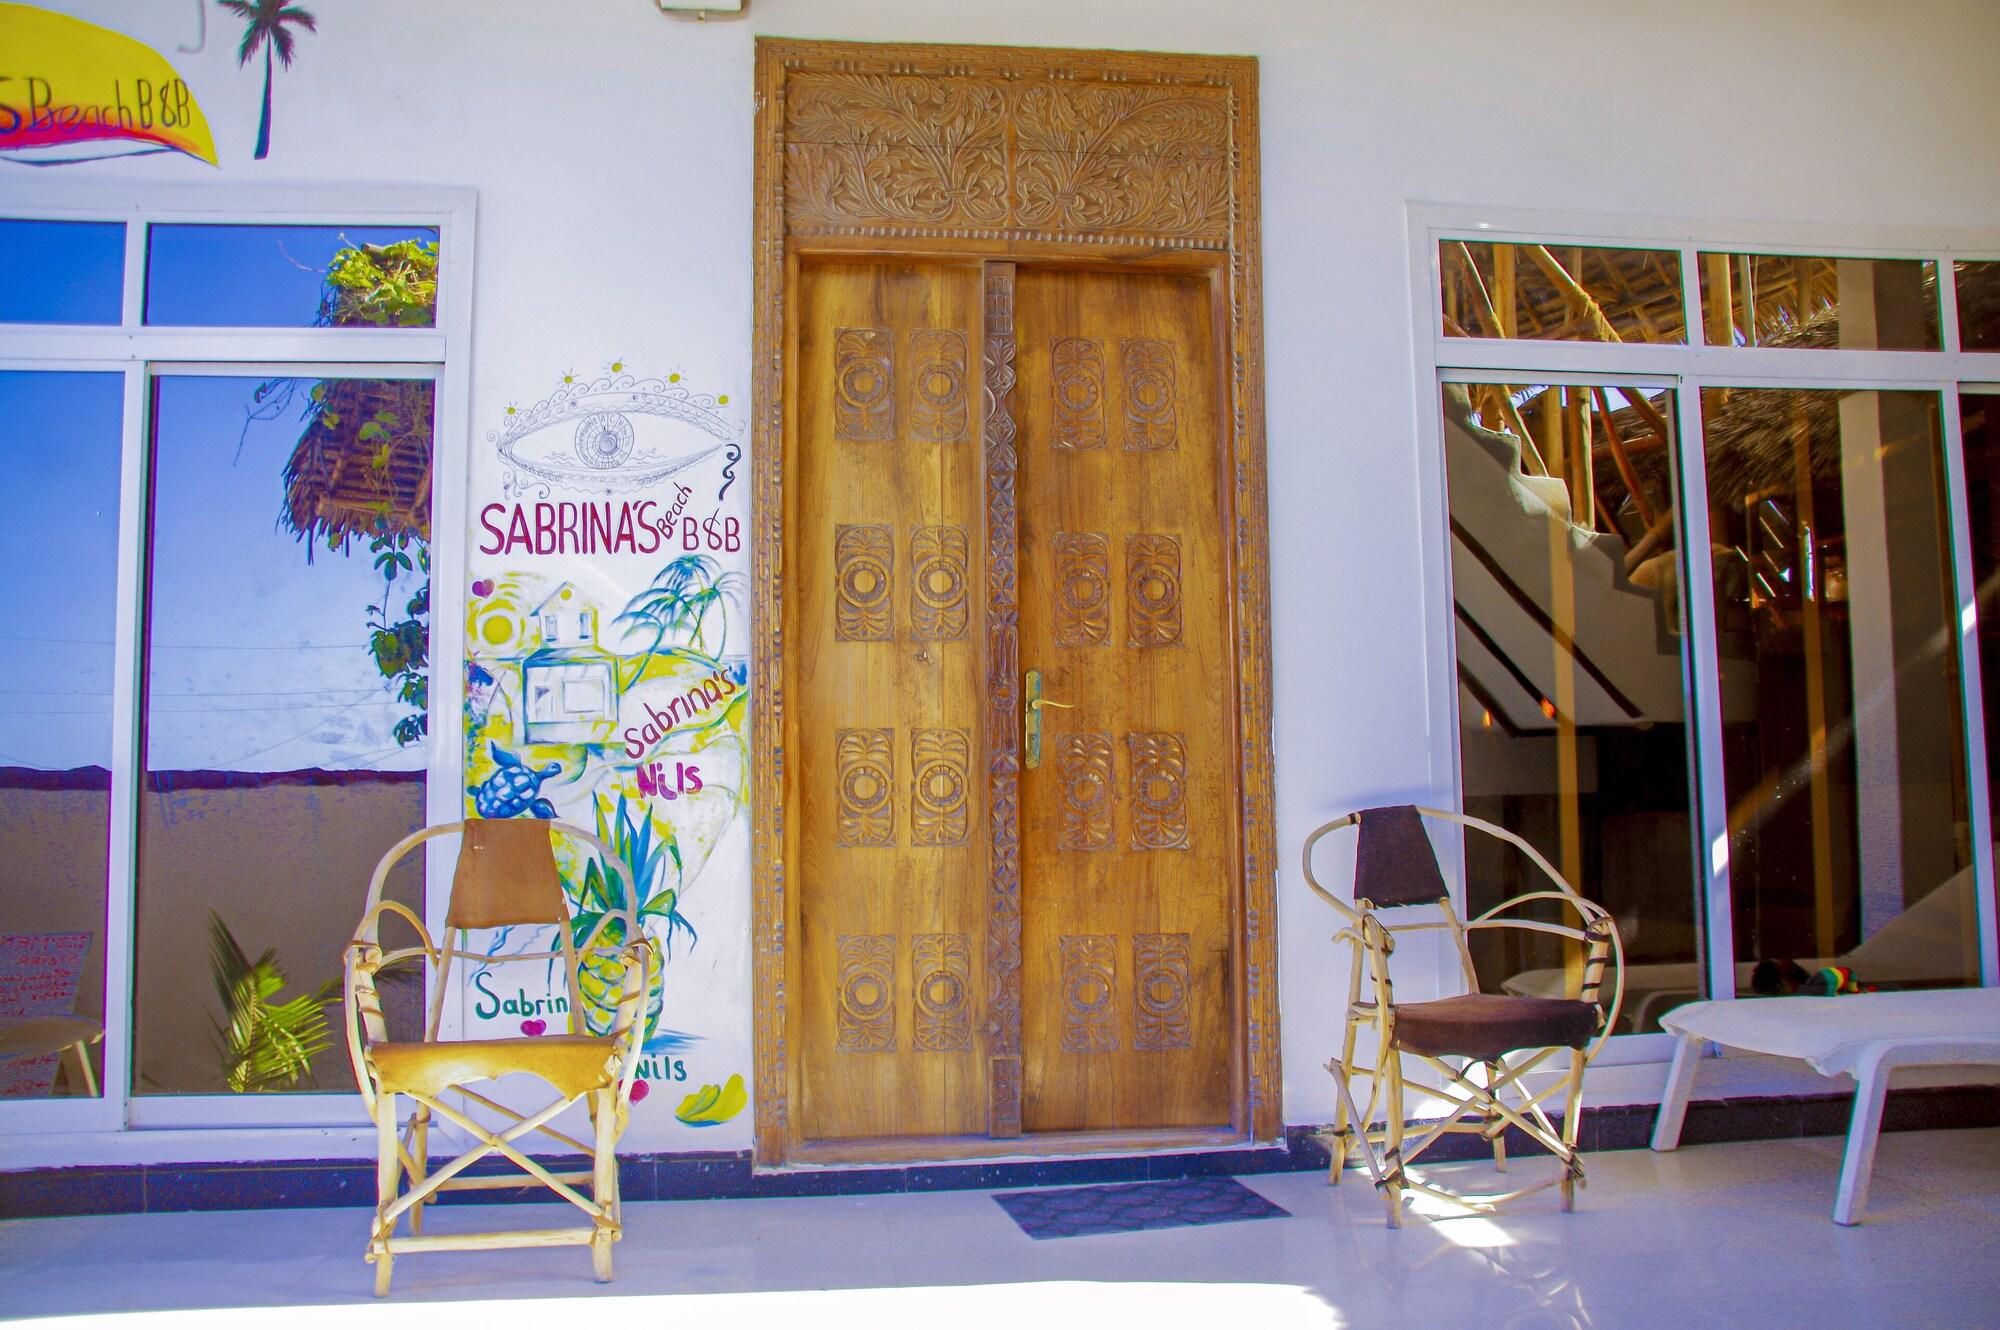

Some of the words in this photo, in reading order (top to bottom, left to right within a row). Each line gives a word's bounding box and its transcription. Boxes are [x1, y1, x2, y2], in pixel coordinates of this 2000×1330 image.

[26, 77, 133, 132] Beach
[480, 501, 660, 555] SABRINA'S
[656, 482, 692, 539] Beach
[624, 669, 736, 759] Sabrina's
[475, 971, 571, 1019] Sabrin
[634, 1053, 687, 1081] Nils
